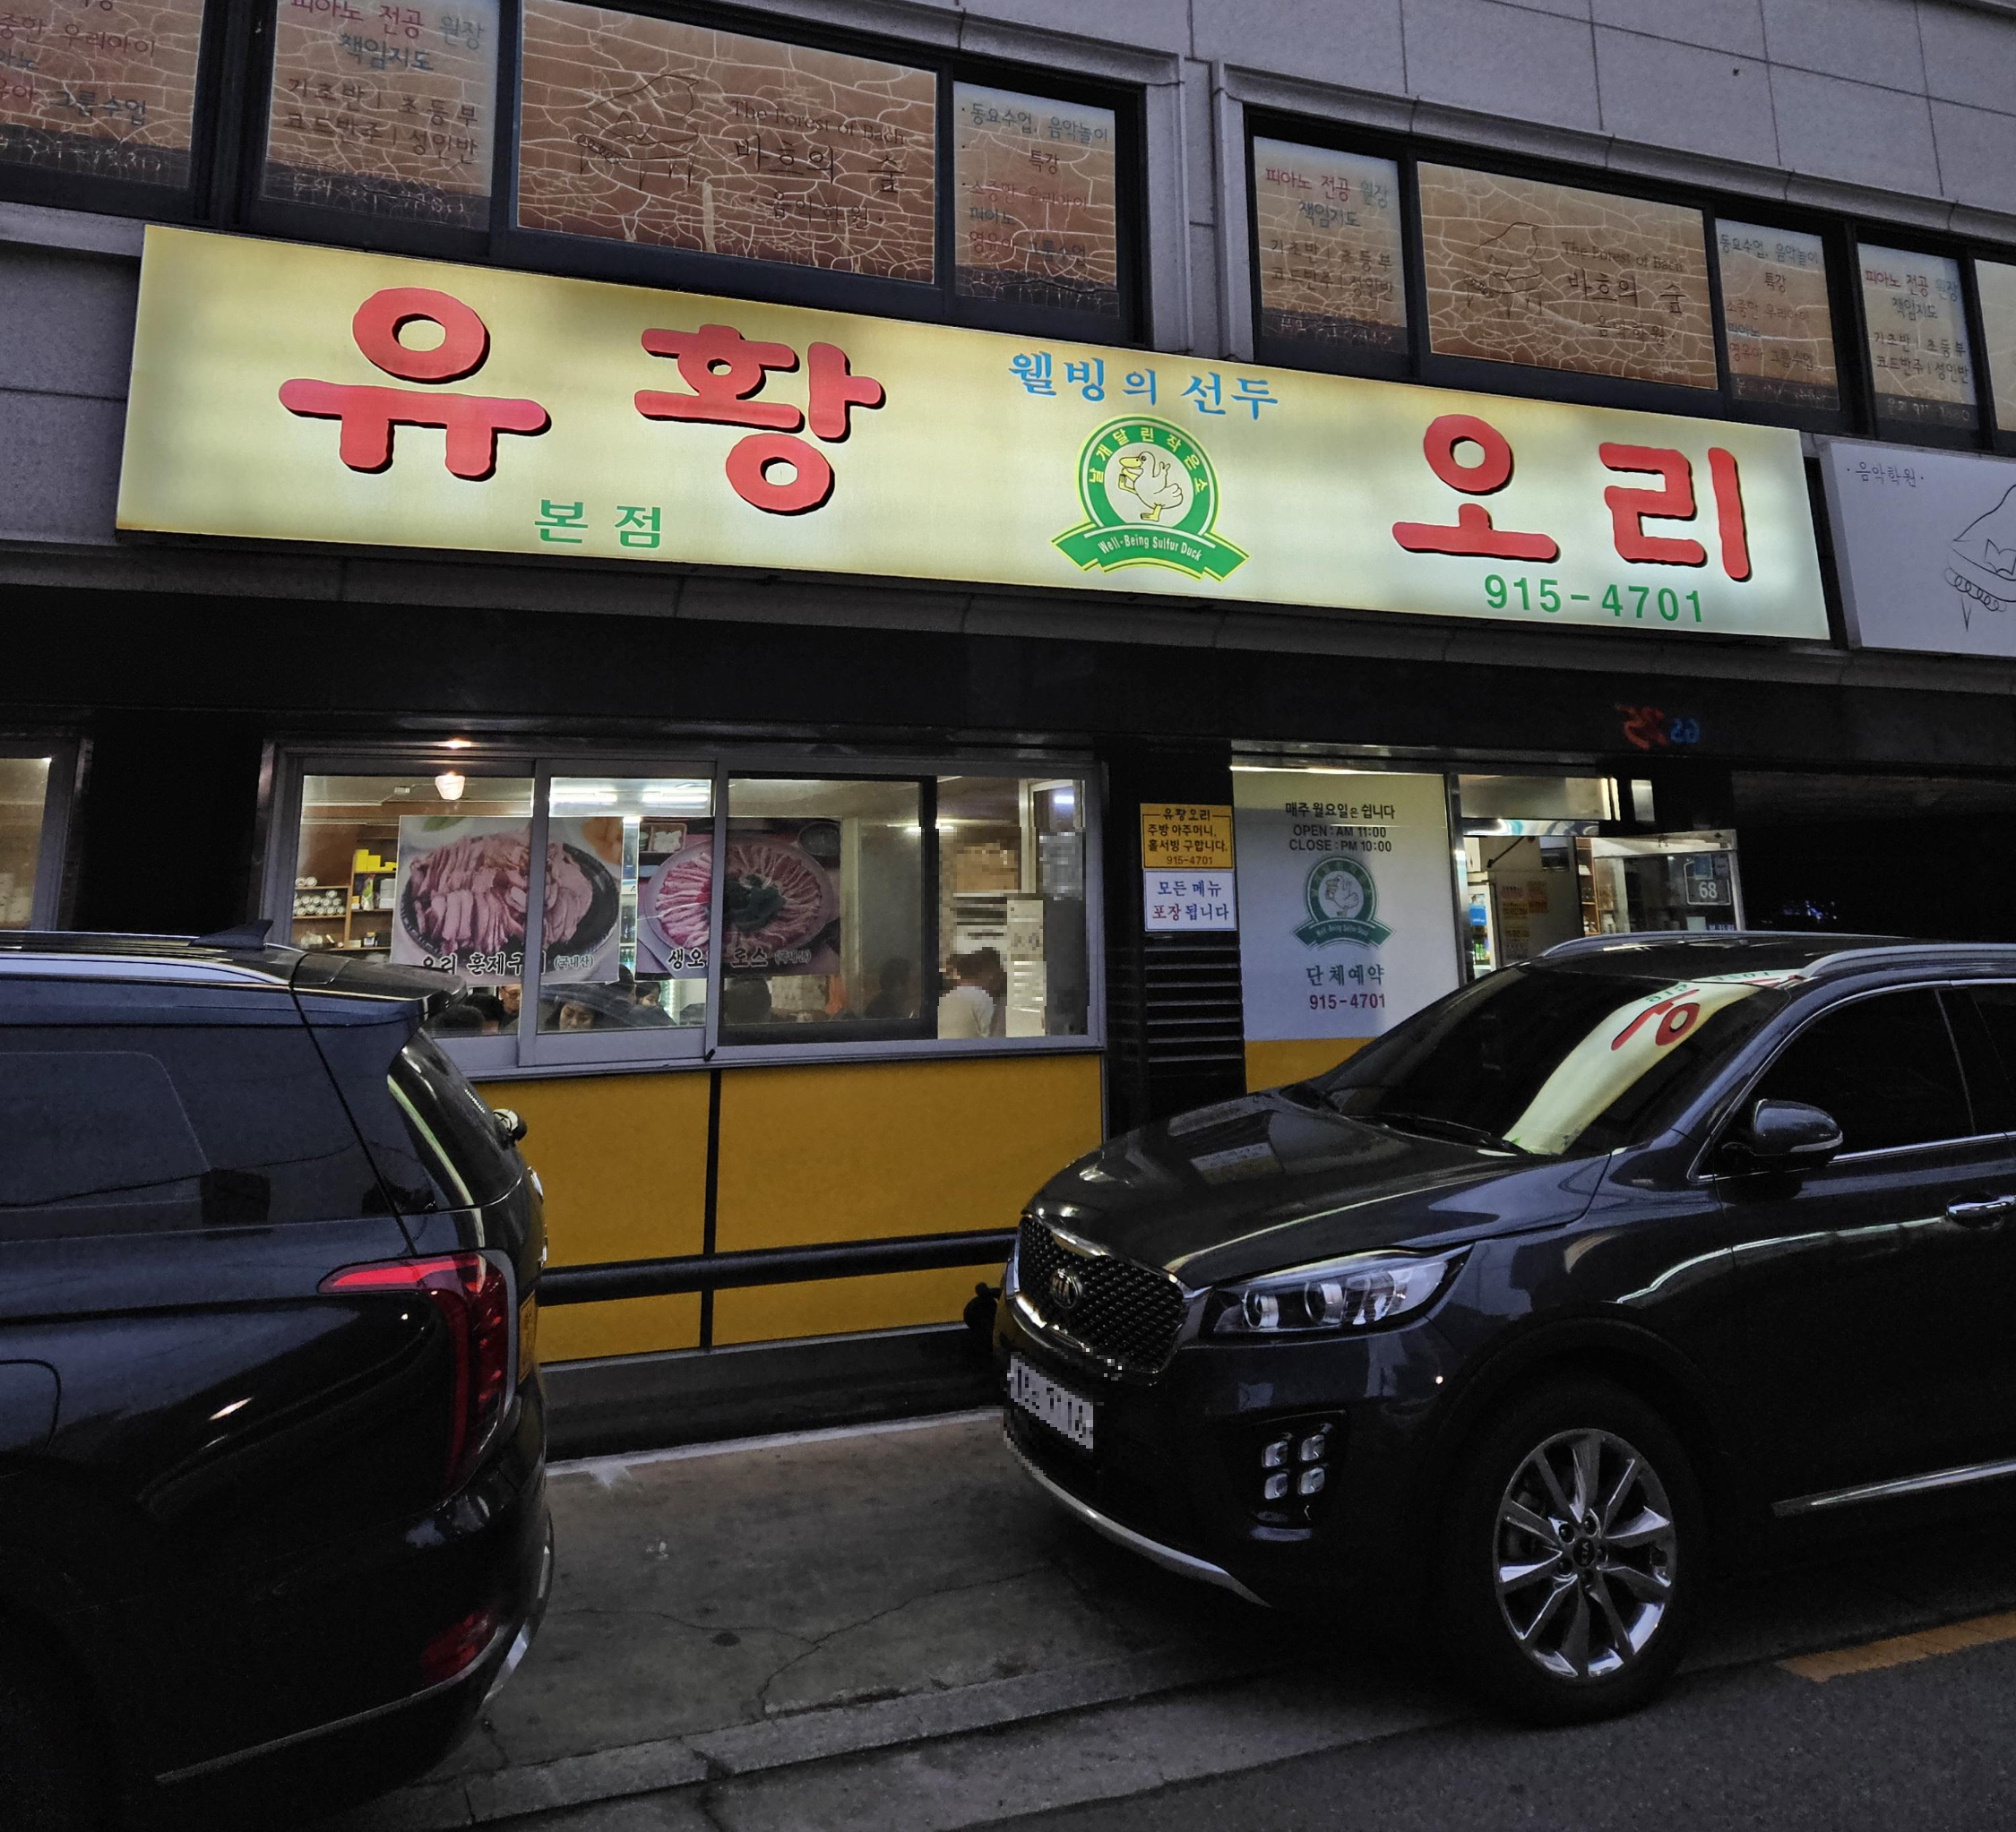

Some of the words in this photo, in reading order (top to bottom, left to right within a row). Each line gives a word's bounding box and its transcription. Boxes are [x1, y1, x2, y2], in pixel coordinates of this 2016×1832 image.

[60, 24, 155, 57] 우리아이
[379, 5, 424, 39] 전공
[440, 16, 485, 50] 원장
[340, 32, 434, 70] 책임지도
[731, 100, 768, 119] The
[774, 108, 831, 133] Forest
[837, 124, 855, 136] of
[864, 125, 905, 145] Bach
[1047, 116, 1108, 145] 음악놀이
[409, 130, 478, 164] 성인반
[735, 133, 834, 185] 바흐의
[867, 155, 905, 194] 숲
[1029, 149, 1060, 175] 특강
[969, 180, 1018, 204] 소중한
[1025, 185, 1087, 211] 우리아이
[1265, 168, 1313, 190] 피아노
[1321, 175, 1351, 202] 전공
[969, 207, 1016, 225] 피아노
[1299, 201, 1361, 228] 책임지도
[1568, 267, 1638, 307] 바흐의
[1660, 284, 1686, 314] 숲
[1764, 271, 1787, 293] 특강
[1865, 270, 1901, 288] 피아노
[1906, 274, 1929, 297] 전공
[1007, 350, 1157, 406] 웰빙의
[1180, 371, 1279, 421] 선두
[535, 498, 663, 549] 본점
[1152, 537, 1178, 552] Sulfur
[1180, 543, 1203, 562] Duck
[1484, 573, 1702, 624] 915-4701
[1285, 802, 1310, 815] 매주
[1361, 804, 1395, 820] 쉽니다
[1148, 824, 1168, 837] 주방
[1335, 826, 1354, 837] AM
[1358, 826, 1386, 839] 11:00
[1340, 840, 1358, 851] PM
[1361, 840, 1391, 852] 10:00
[1167, 856, 1213, 865] 915-4701
[1158, 881, 1187, 896] 모든
[1192, 880, 1222, 898] 메뉴
[1699, 882, 1718, 899] 68
[1152, 903, 1182, 921] 포장
[1185, 903, 1229, 921] 됩니다
[668, 948, 709, 971] 생오
[730, 947, 768, 968] 로스
[1310, 993, 1385, 1010] 915-4701
